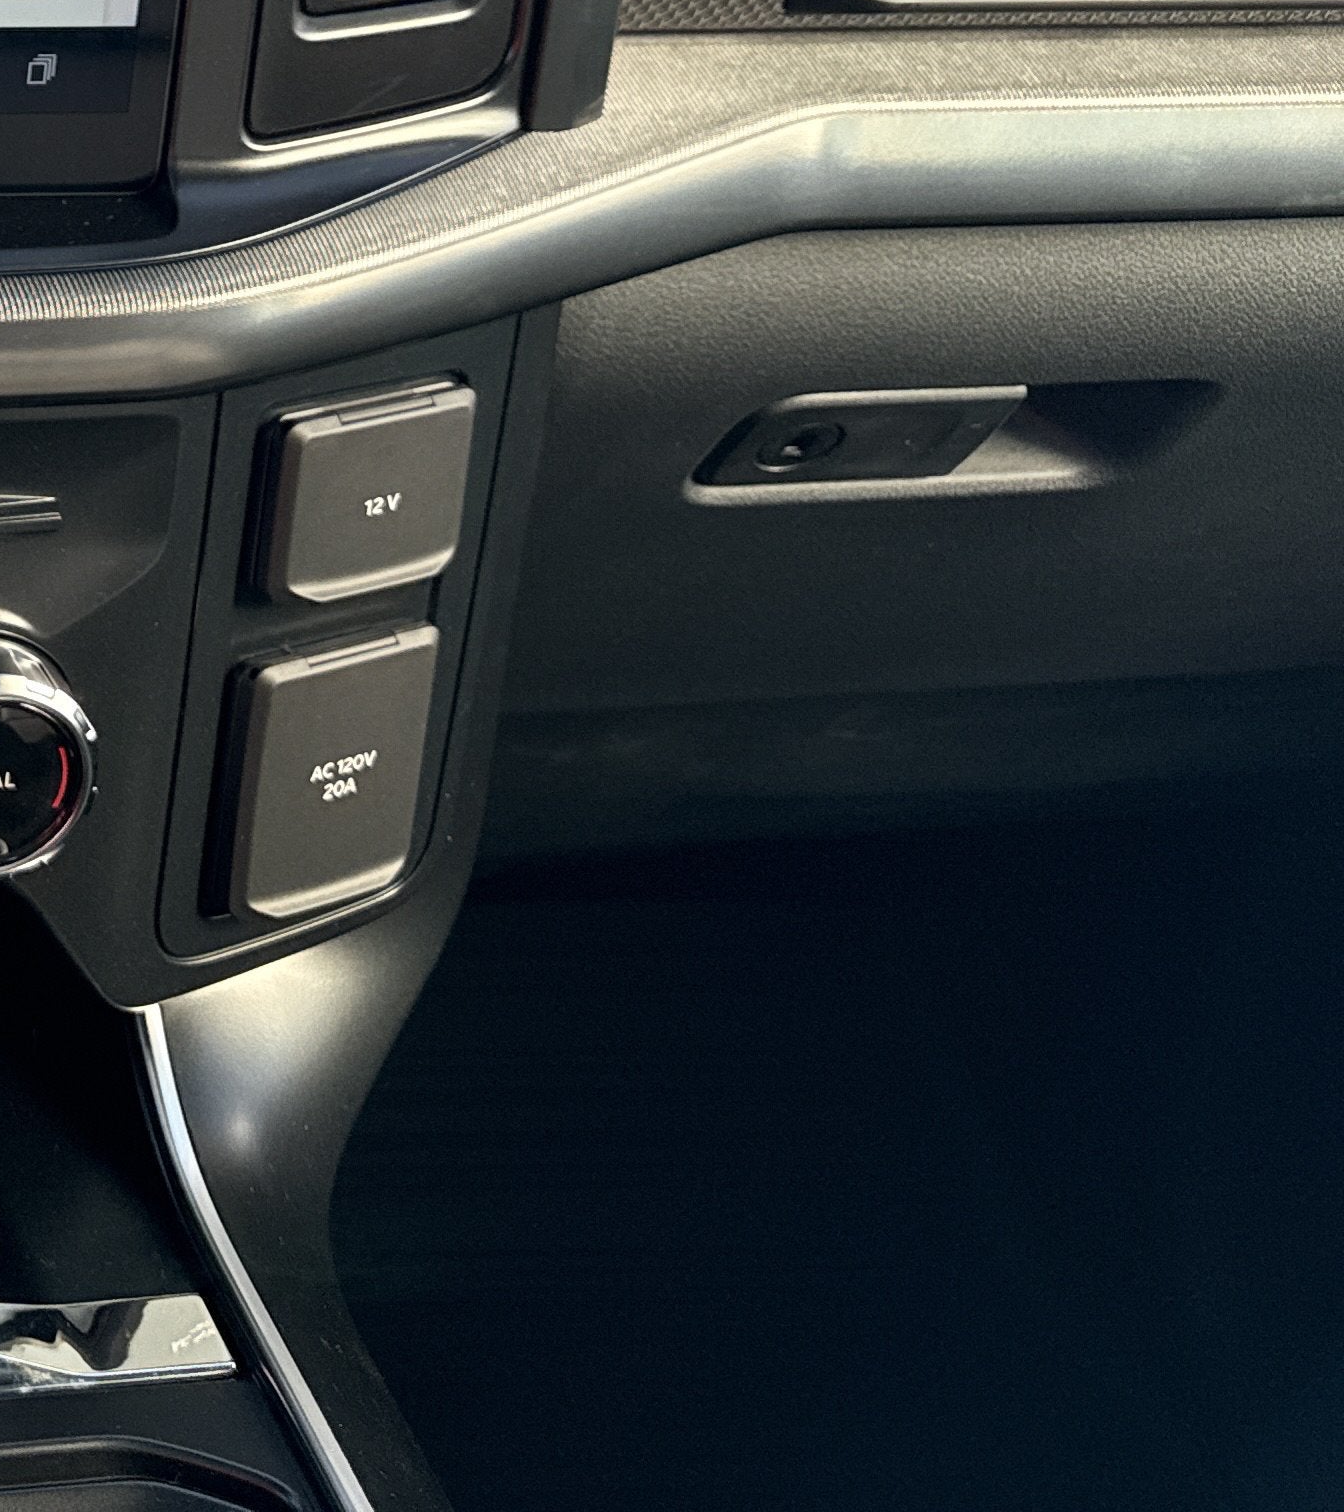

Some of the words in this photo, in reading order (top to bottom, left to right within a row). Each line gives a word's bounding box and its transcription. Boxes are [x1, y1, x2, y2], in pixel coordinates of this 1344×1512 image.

[364, 495, 386, 517] 12
[386, 492, 403, 512] V
[310, 760, 336, 784] AC
[336, 750, 378, 776] 120V
[322, 778, 358, 802] 20A
